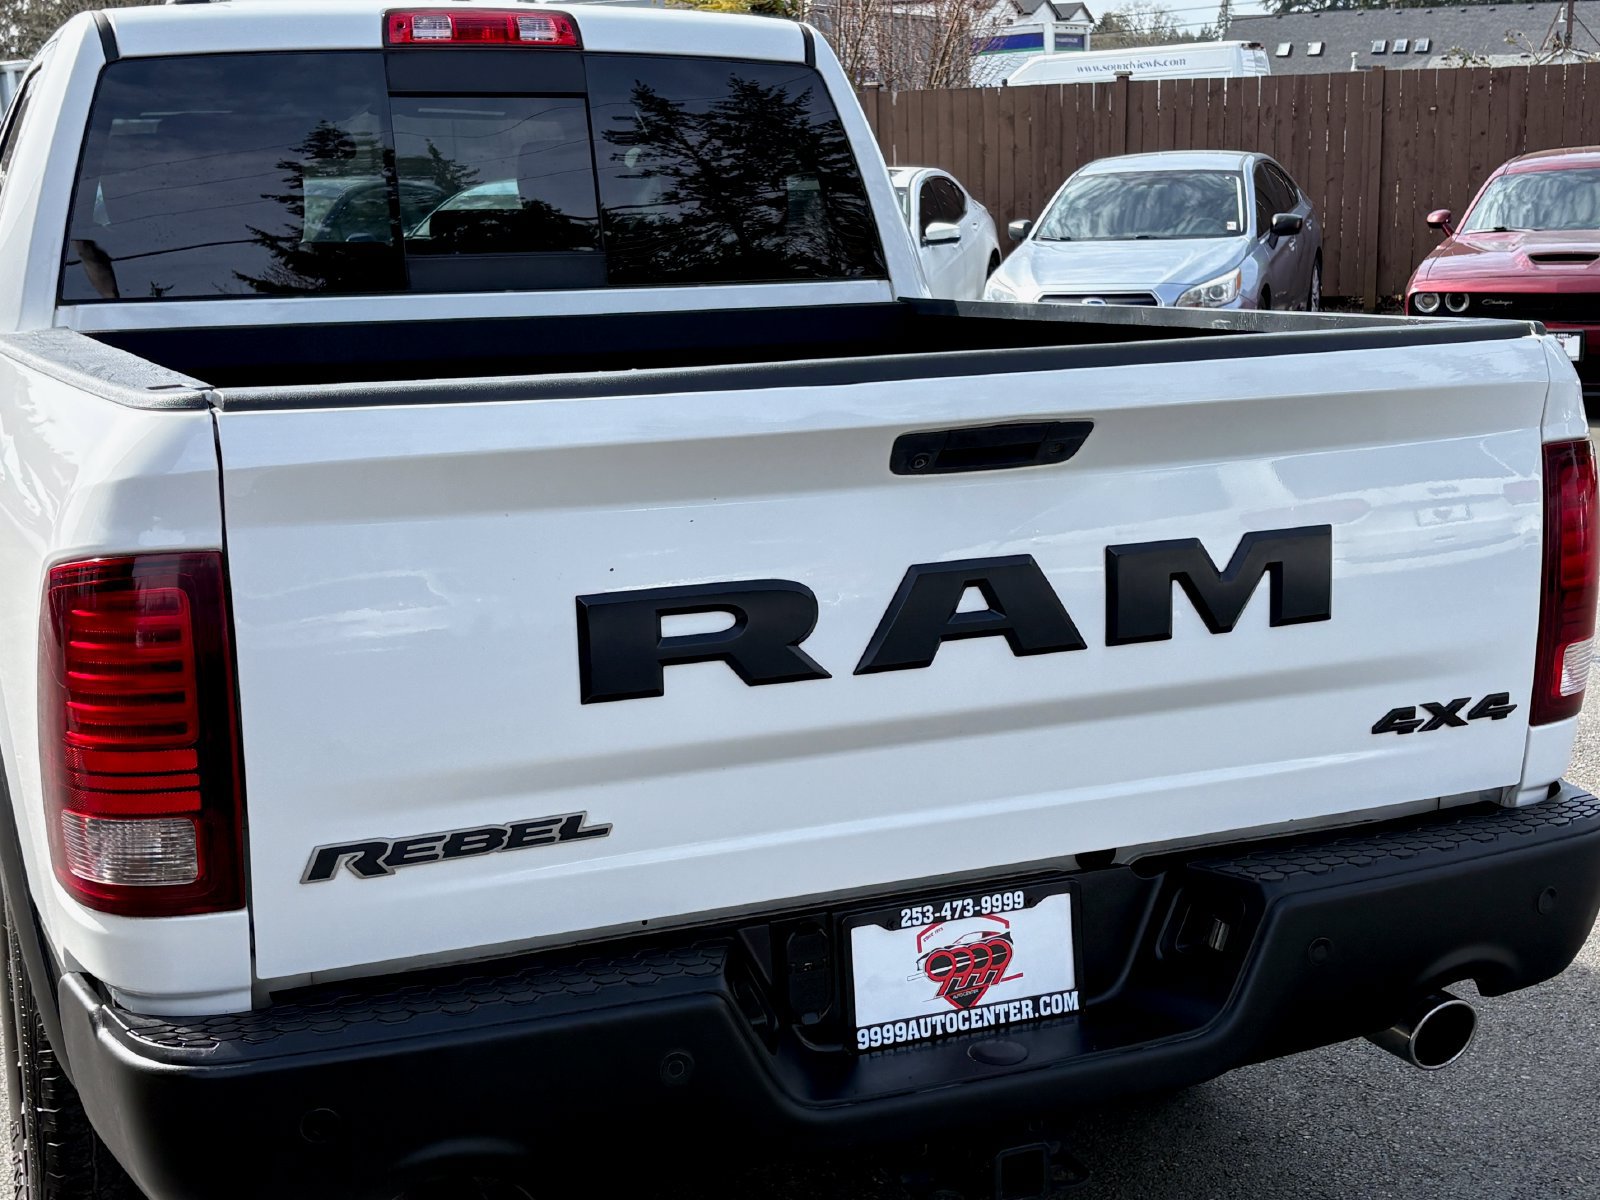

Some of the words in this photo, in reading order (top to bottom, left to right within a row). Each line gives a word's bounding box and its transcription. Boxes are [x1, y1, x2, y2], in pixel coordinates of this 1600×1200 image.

[576, 524, 1333, 704] RAM
[300, 810, 613, 884] REBEL
[900, 890, 1025, 927] 253-473-9999
[856, 990, 1079, 1050] 9999AUTOCENTER.COM
